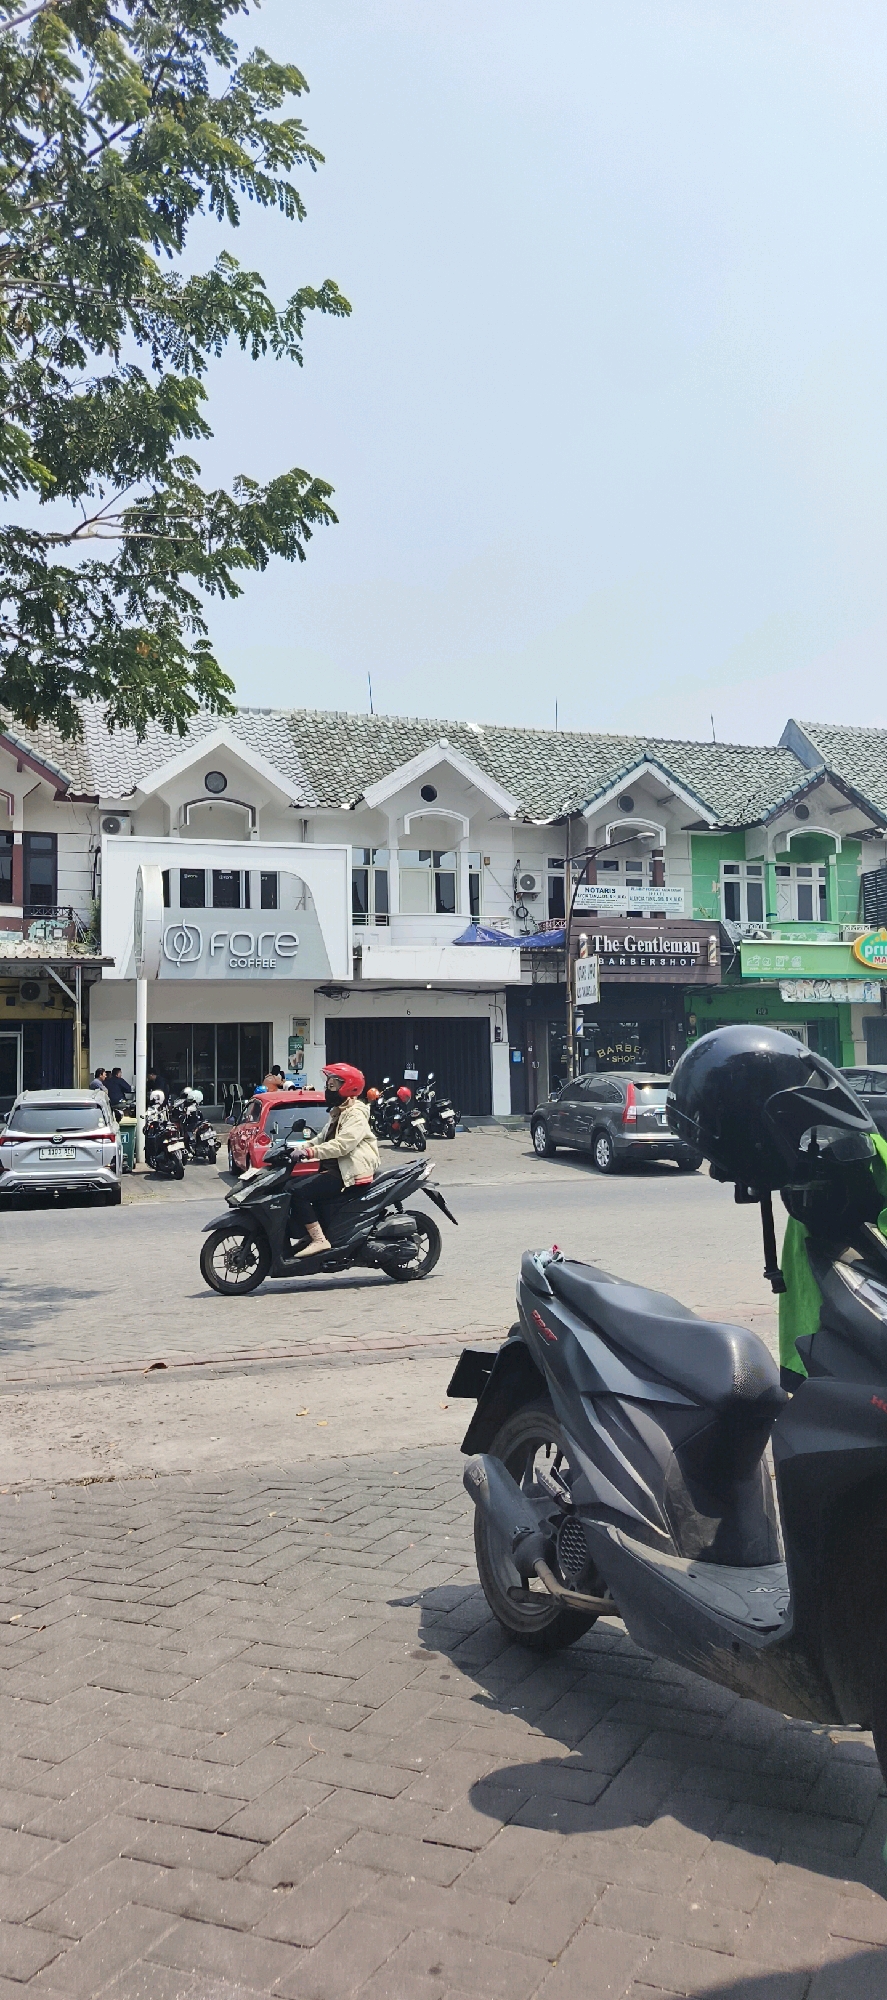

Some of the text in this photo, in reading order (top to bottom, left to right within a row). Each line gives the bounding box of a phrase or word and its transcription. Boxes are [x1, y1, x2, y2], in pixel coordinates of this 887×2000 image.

[592, 934, 700, 954] The Gentleman
[229, 958, 277, 968] COFFEE
[599, 958, 696, 966] BARBERSHOP
